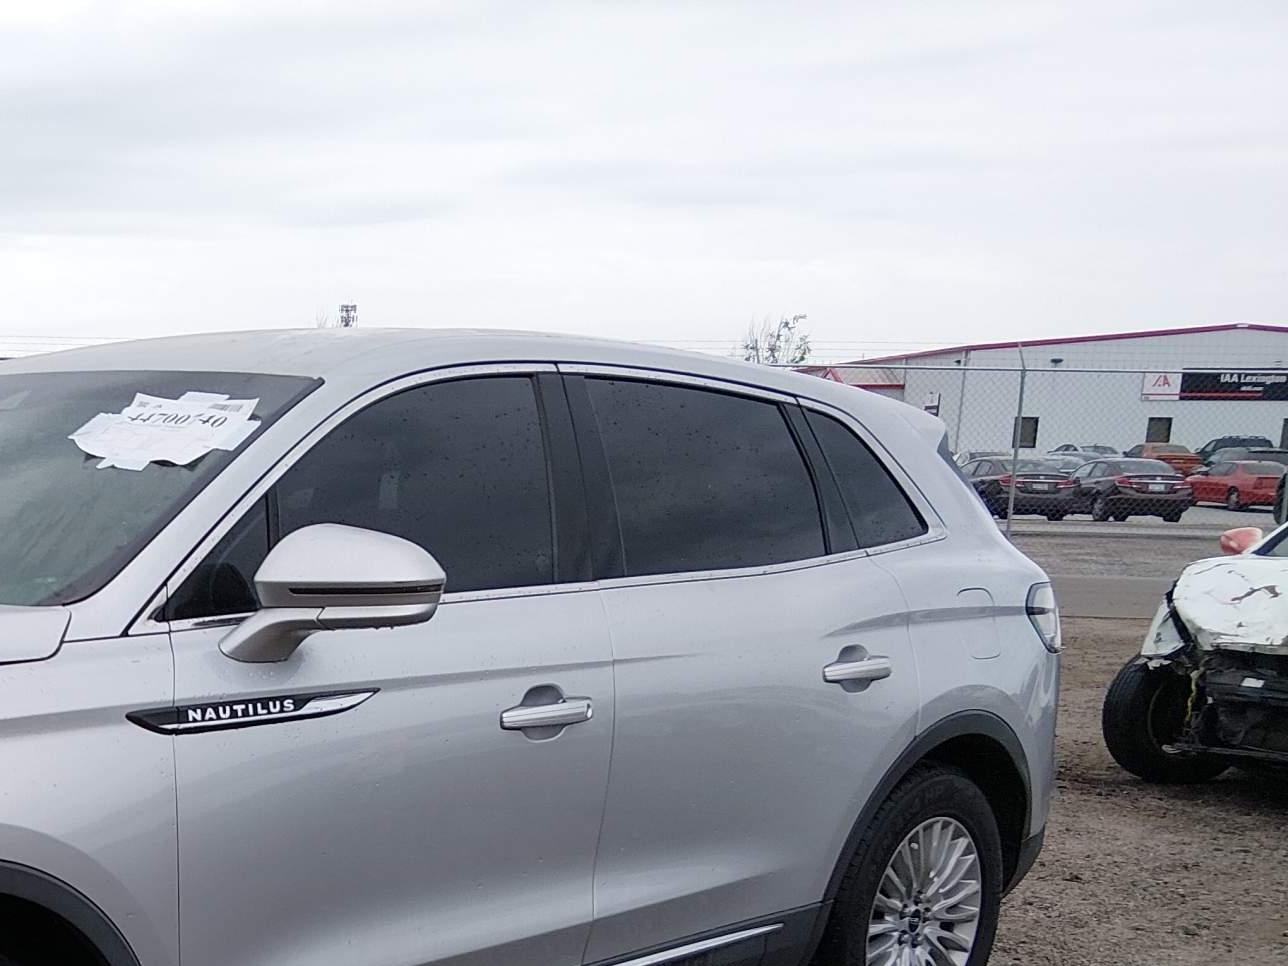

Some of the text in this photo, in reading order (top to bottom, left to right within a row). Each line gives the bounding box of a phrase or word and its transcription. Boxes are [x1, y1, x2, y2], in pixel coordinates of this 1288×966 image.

[1220, 373, 1287, 385] IAA Lexington
[127, 412, 228, 428] 44700740
[186, 698, 295, 722] NAUTILUS
